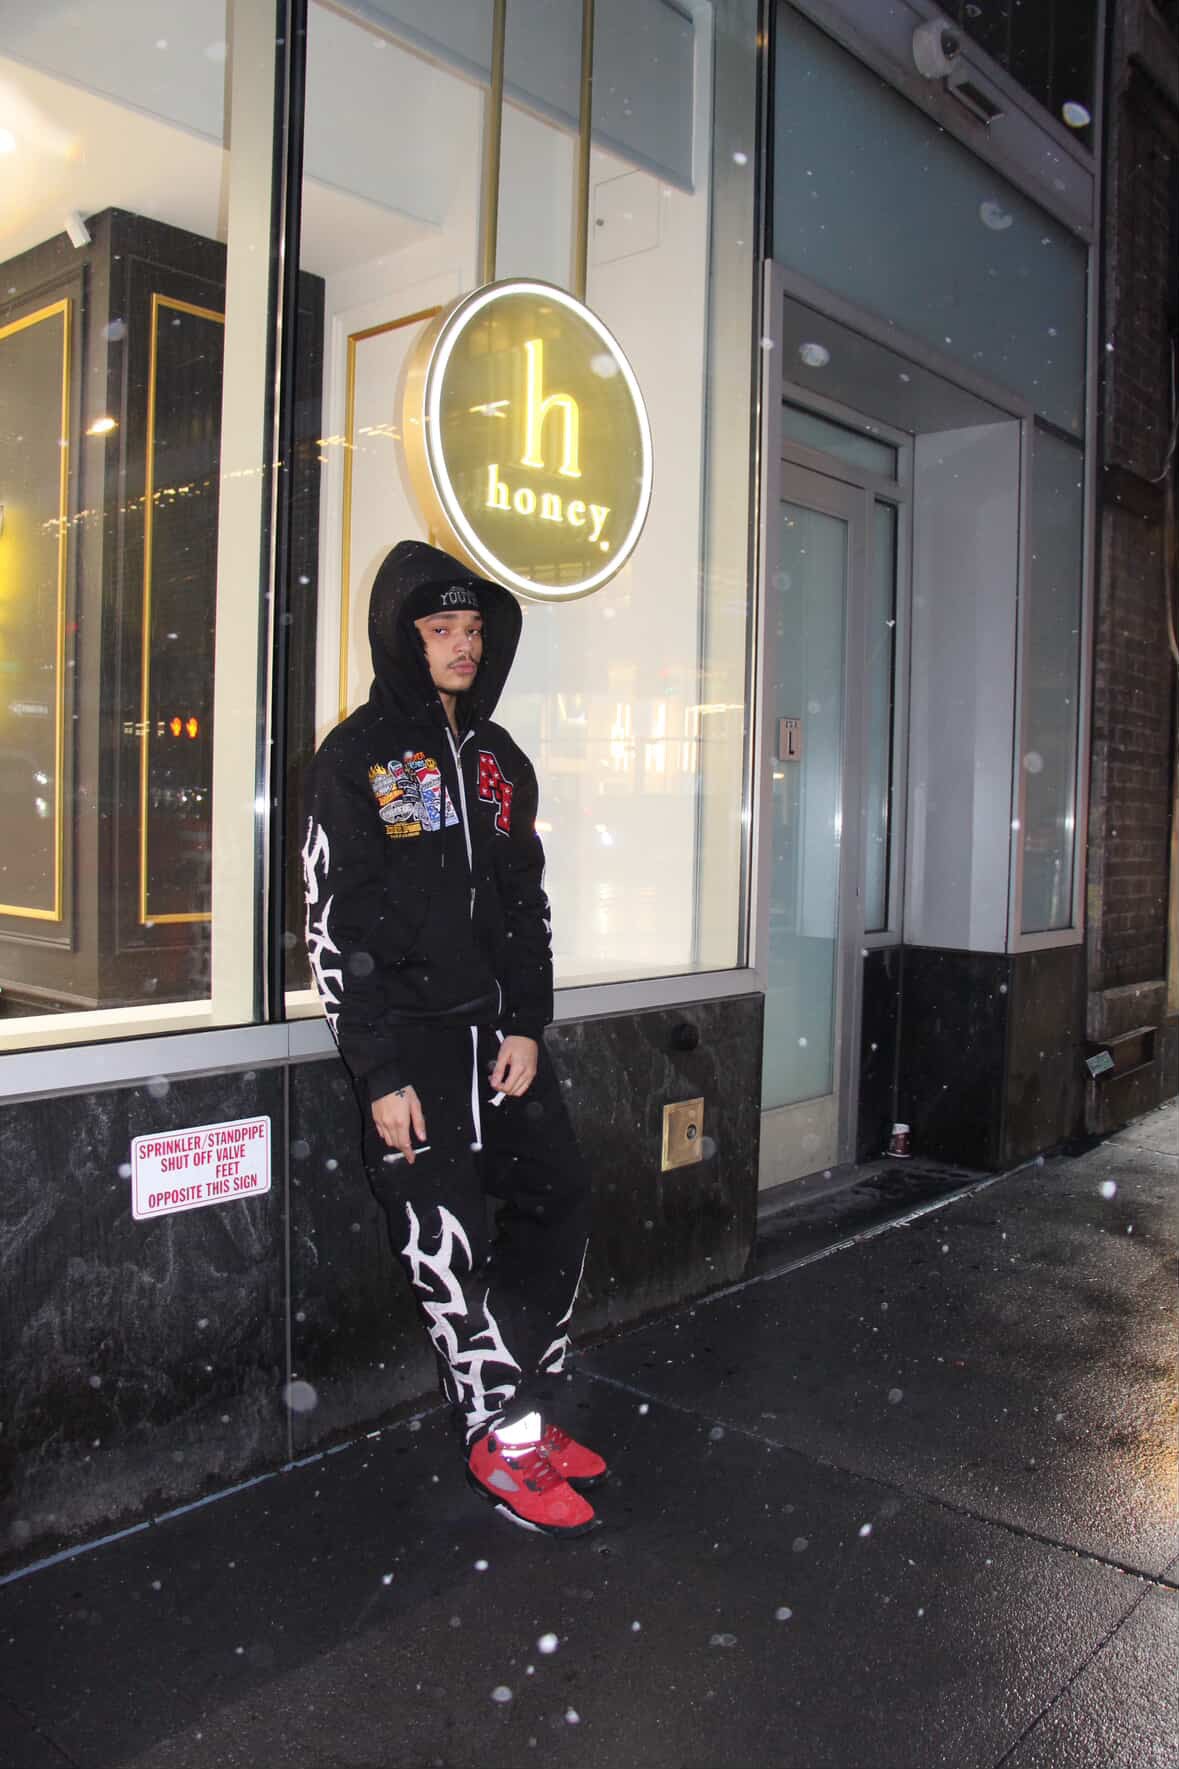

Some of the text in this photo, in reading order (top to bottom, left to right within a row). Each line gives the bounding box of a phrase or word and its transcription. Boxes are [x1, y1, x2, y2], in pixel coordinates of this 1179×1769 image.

[520, 338, 582, 478] h
[139, 1124, 265, 1159] SPRINKLER/STANDPIPE
[161, 1144, 246, 1173] SHUT OFF VALVE
[216, 1161, 240, 1178] FEET
[148, 1174, 257, 1209] OPPOSITE THIS SIGN
